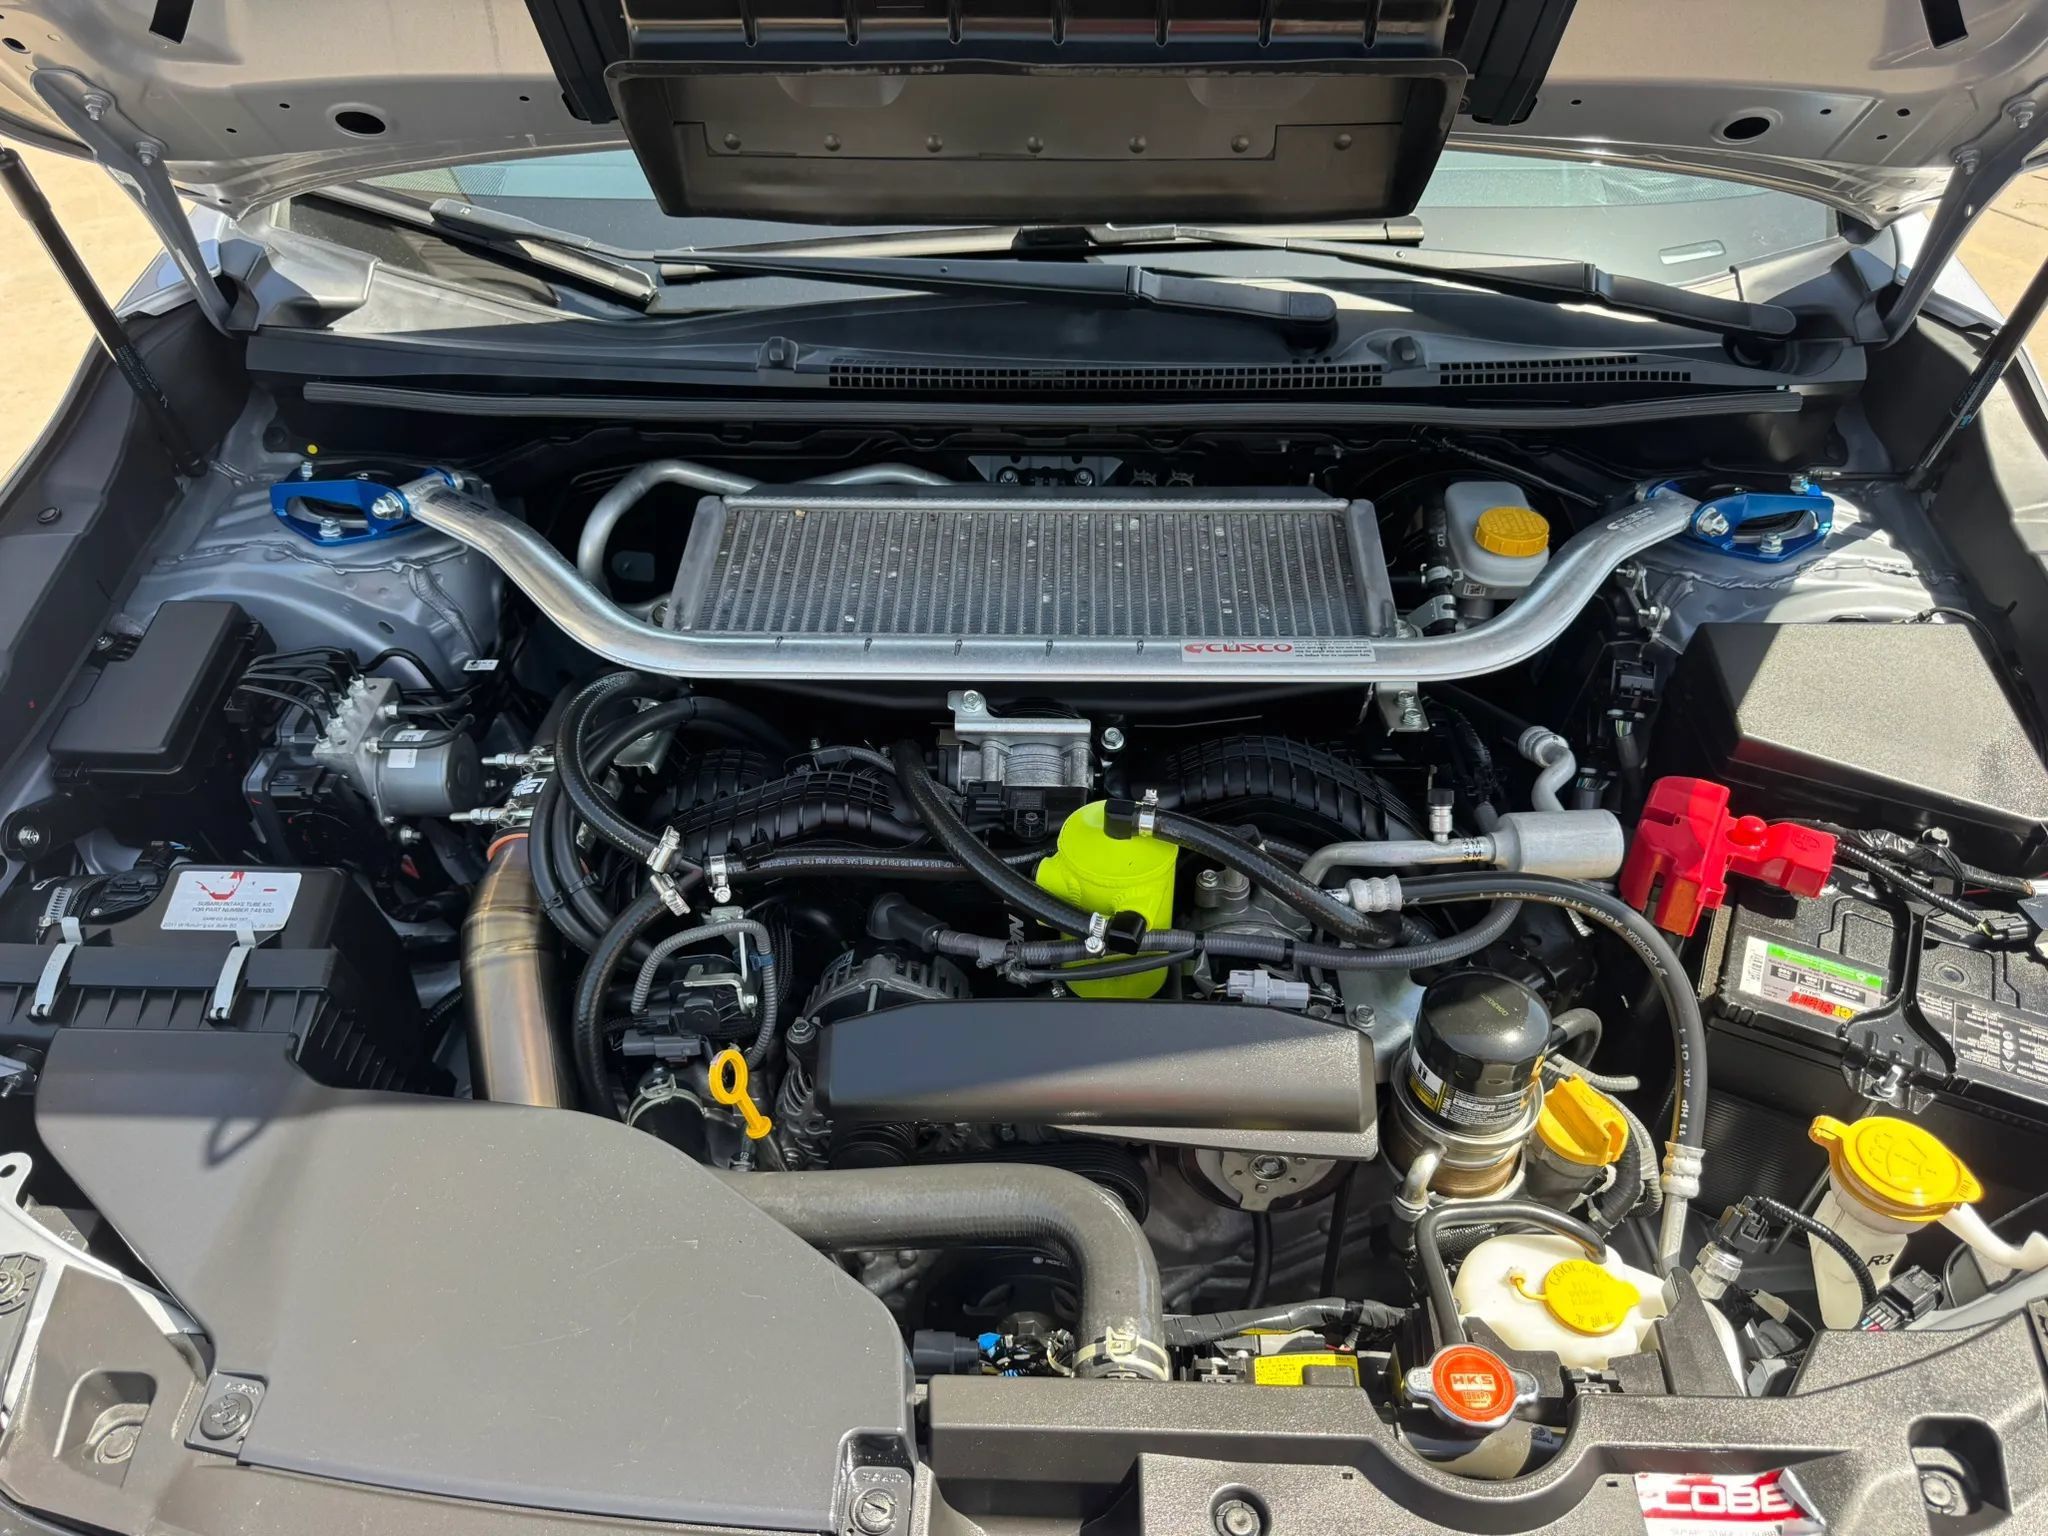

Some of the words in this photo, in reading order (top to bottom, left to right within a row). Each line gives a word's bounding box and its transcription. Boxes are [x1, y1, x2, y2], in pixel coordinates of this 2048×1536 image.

[1205, 641, 1293, 653] CUSCO
[1549, 895, 1567, 904] HP
[1626, 927, 1661, 968] YOKOHAMA
[1683, 1068, 1692, 1088] AK
[1680, 1099, 1691, 1118] HP
[1867, 1254, 1894, 1267] R3
[1452, 1375, 1494, 1386] HKS
